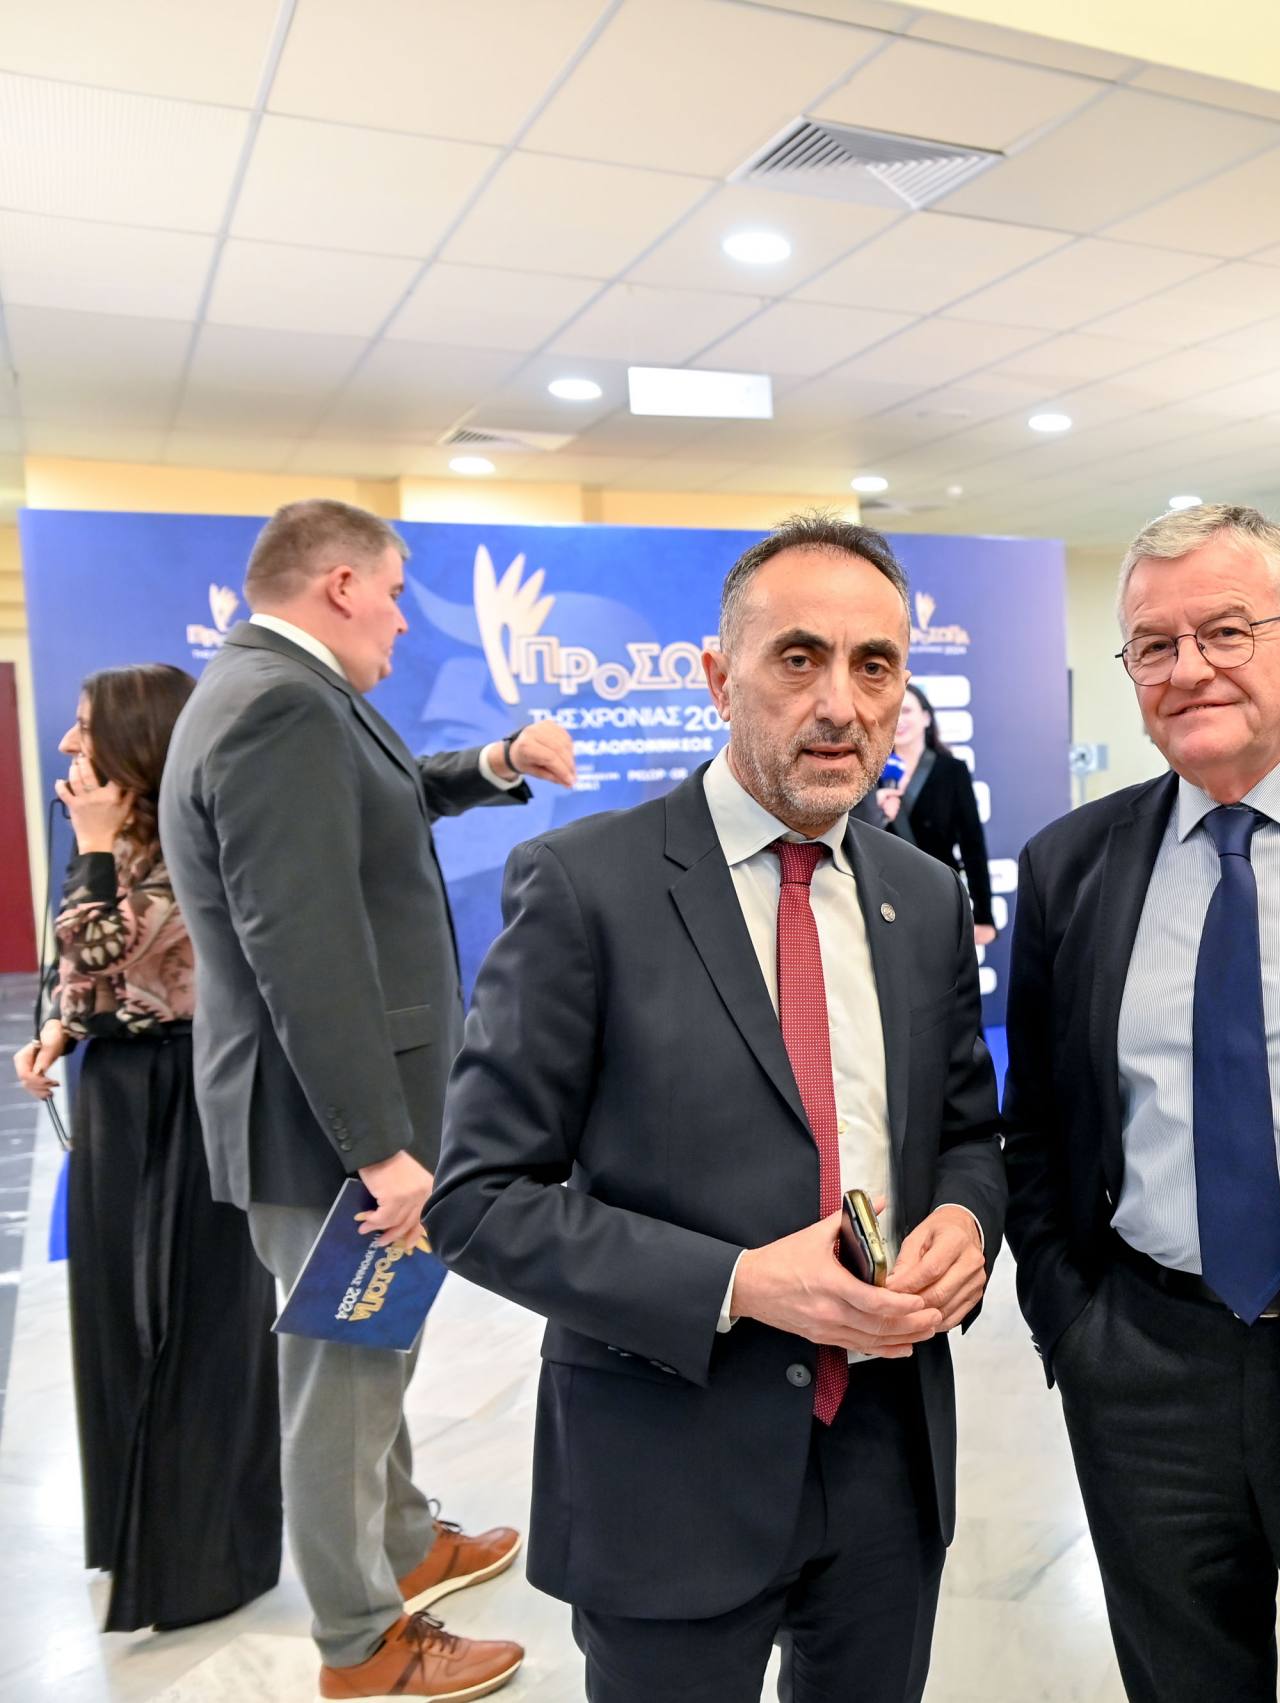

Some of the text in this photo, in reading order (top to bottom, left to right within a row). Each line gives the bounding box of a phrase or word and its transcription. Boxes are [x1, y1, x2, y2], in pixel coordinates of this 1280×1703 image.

[579, 705, 683, 729] ΧΡΟΝΙΑΣ
[684, 704, 731, 731] 20
[334, 1286, 362, 1320] 2024
